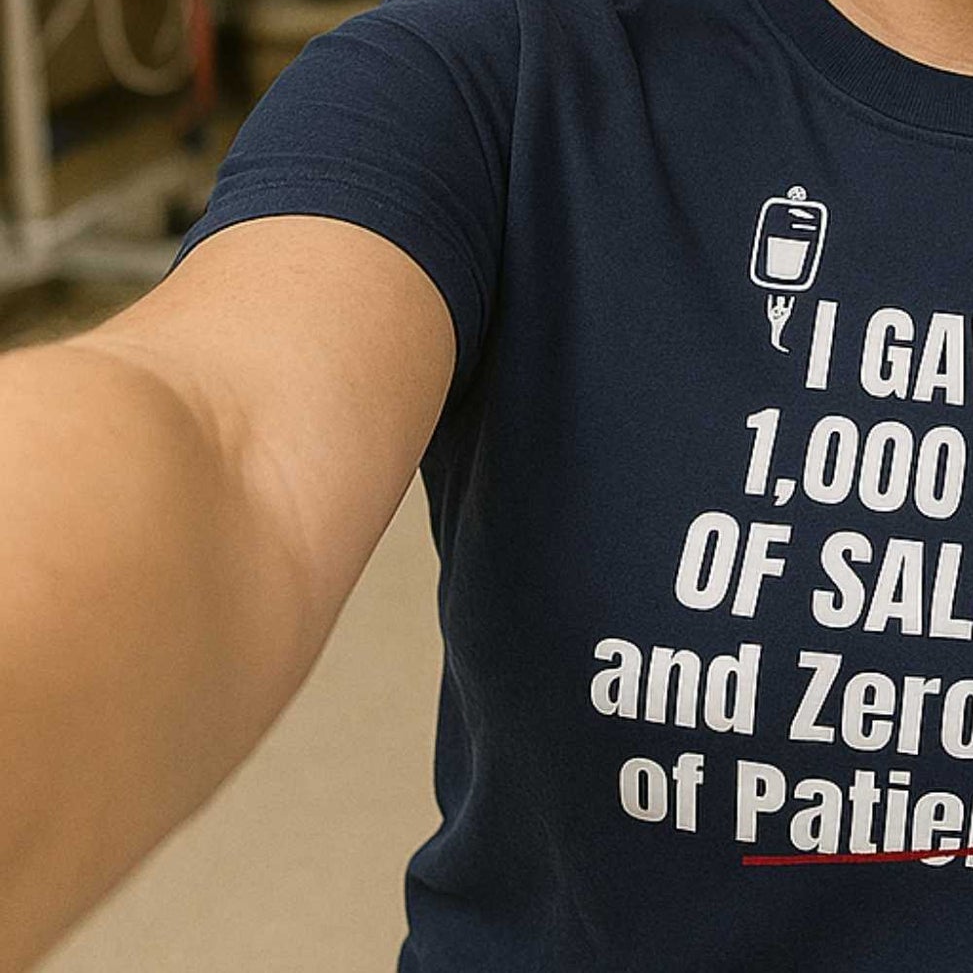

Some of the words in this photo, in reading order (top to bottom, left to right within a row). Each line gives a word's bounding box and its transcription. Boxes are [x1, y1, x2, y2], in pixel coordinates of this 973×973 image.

[805, 299, 838, 390] I
[744, 408, 966, 519] 1,000
[675, 511, 792, 618] OF
[590, 638, 762, 735] and
[619, 752, 704, 833] of
